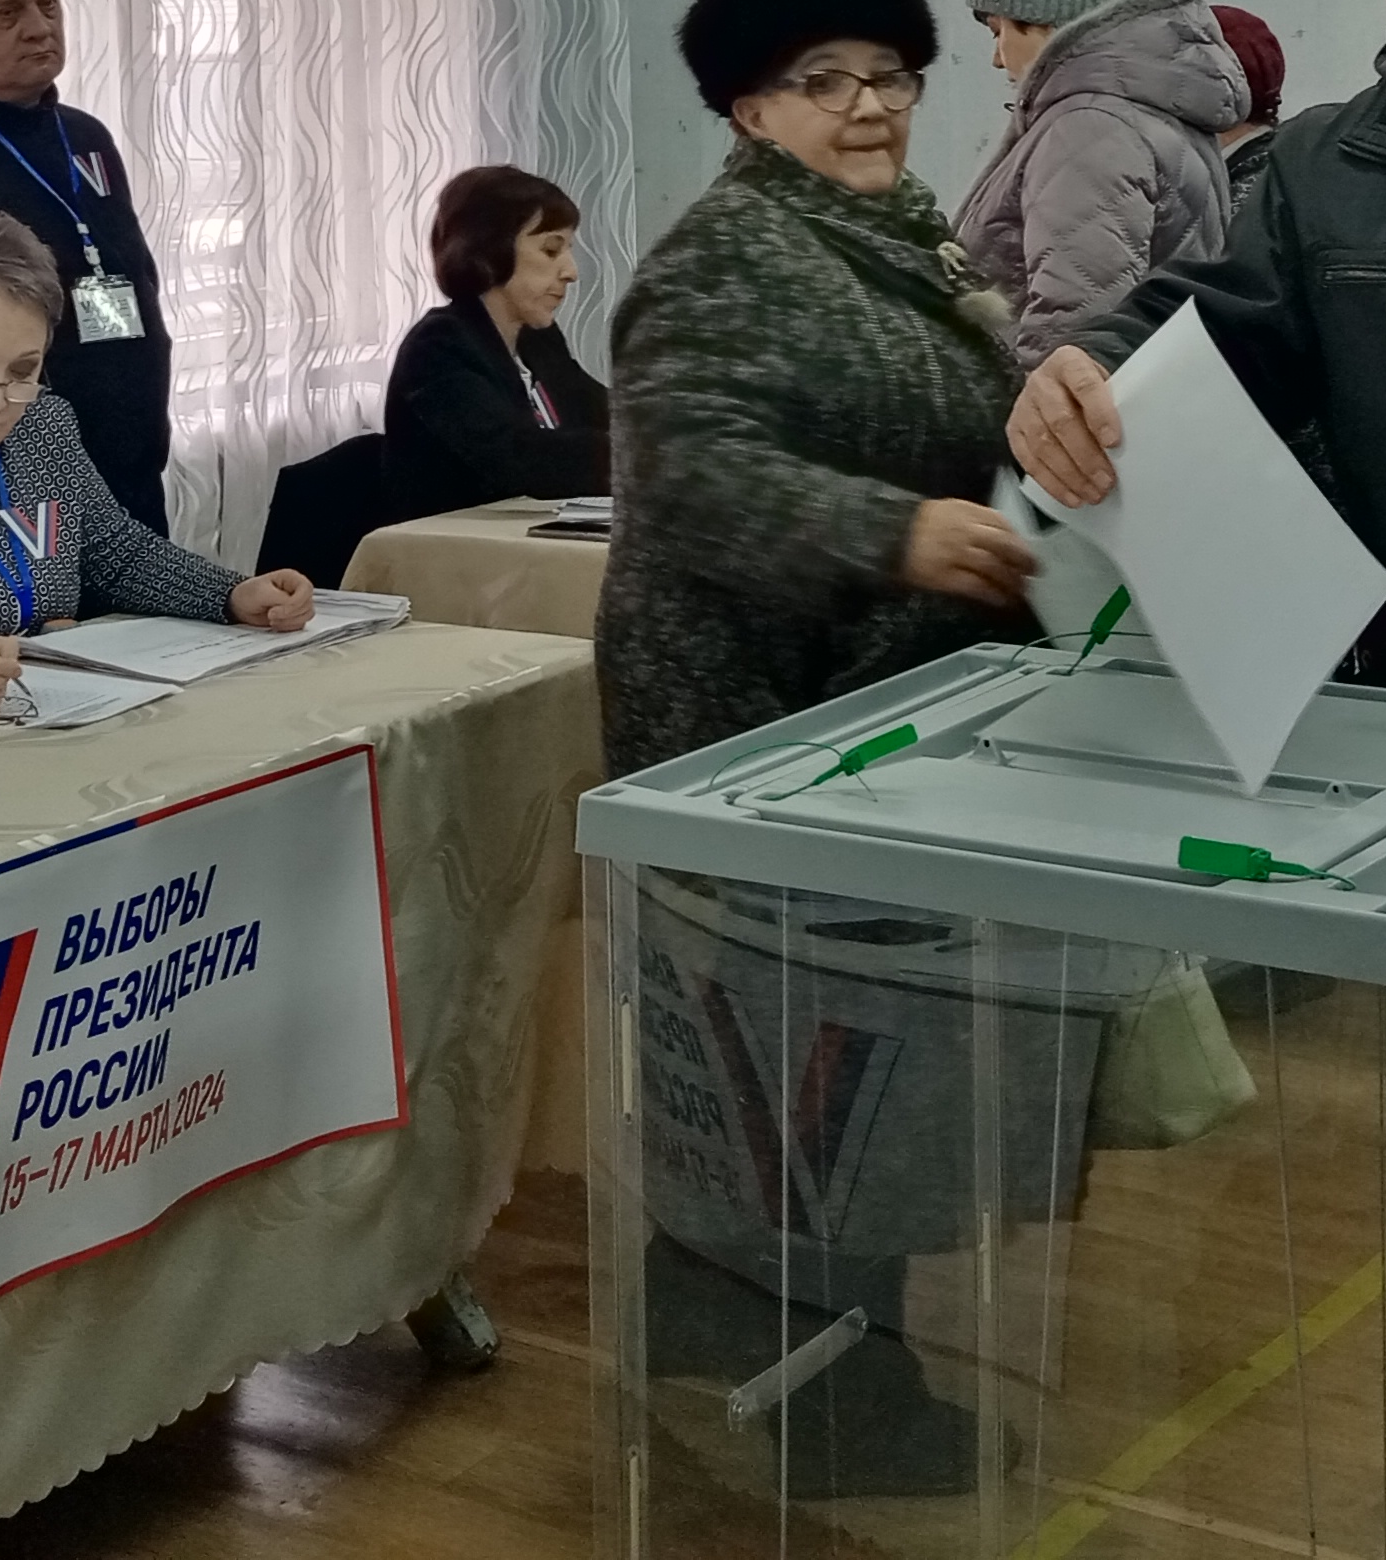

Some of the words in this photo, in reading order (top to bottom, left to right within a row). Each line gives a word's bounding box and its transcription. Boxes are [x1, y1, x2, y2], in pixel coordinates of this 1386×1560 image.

[53, 864, 217, 974] ВЫБОРЫ
[31, 920, 261, 1058] ПРЕЗИДЕНТА
[12, 1028, 171, 1142] РОССИИ
[84, 1098, 171, 1182] МАРТА
[171, 1069, 226, 1139] 2024
